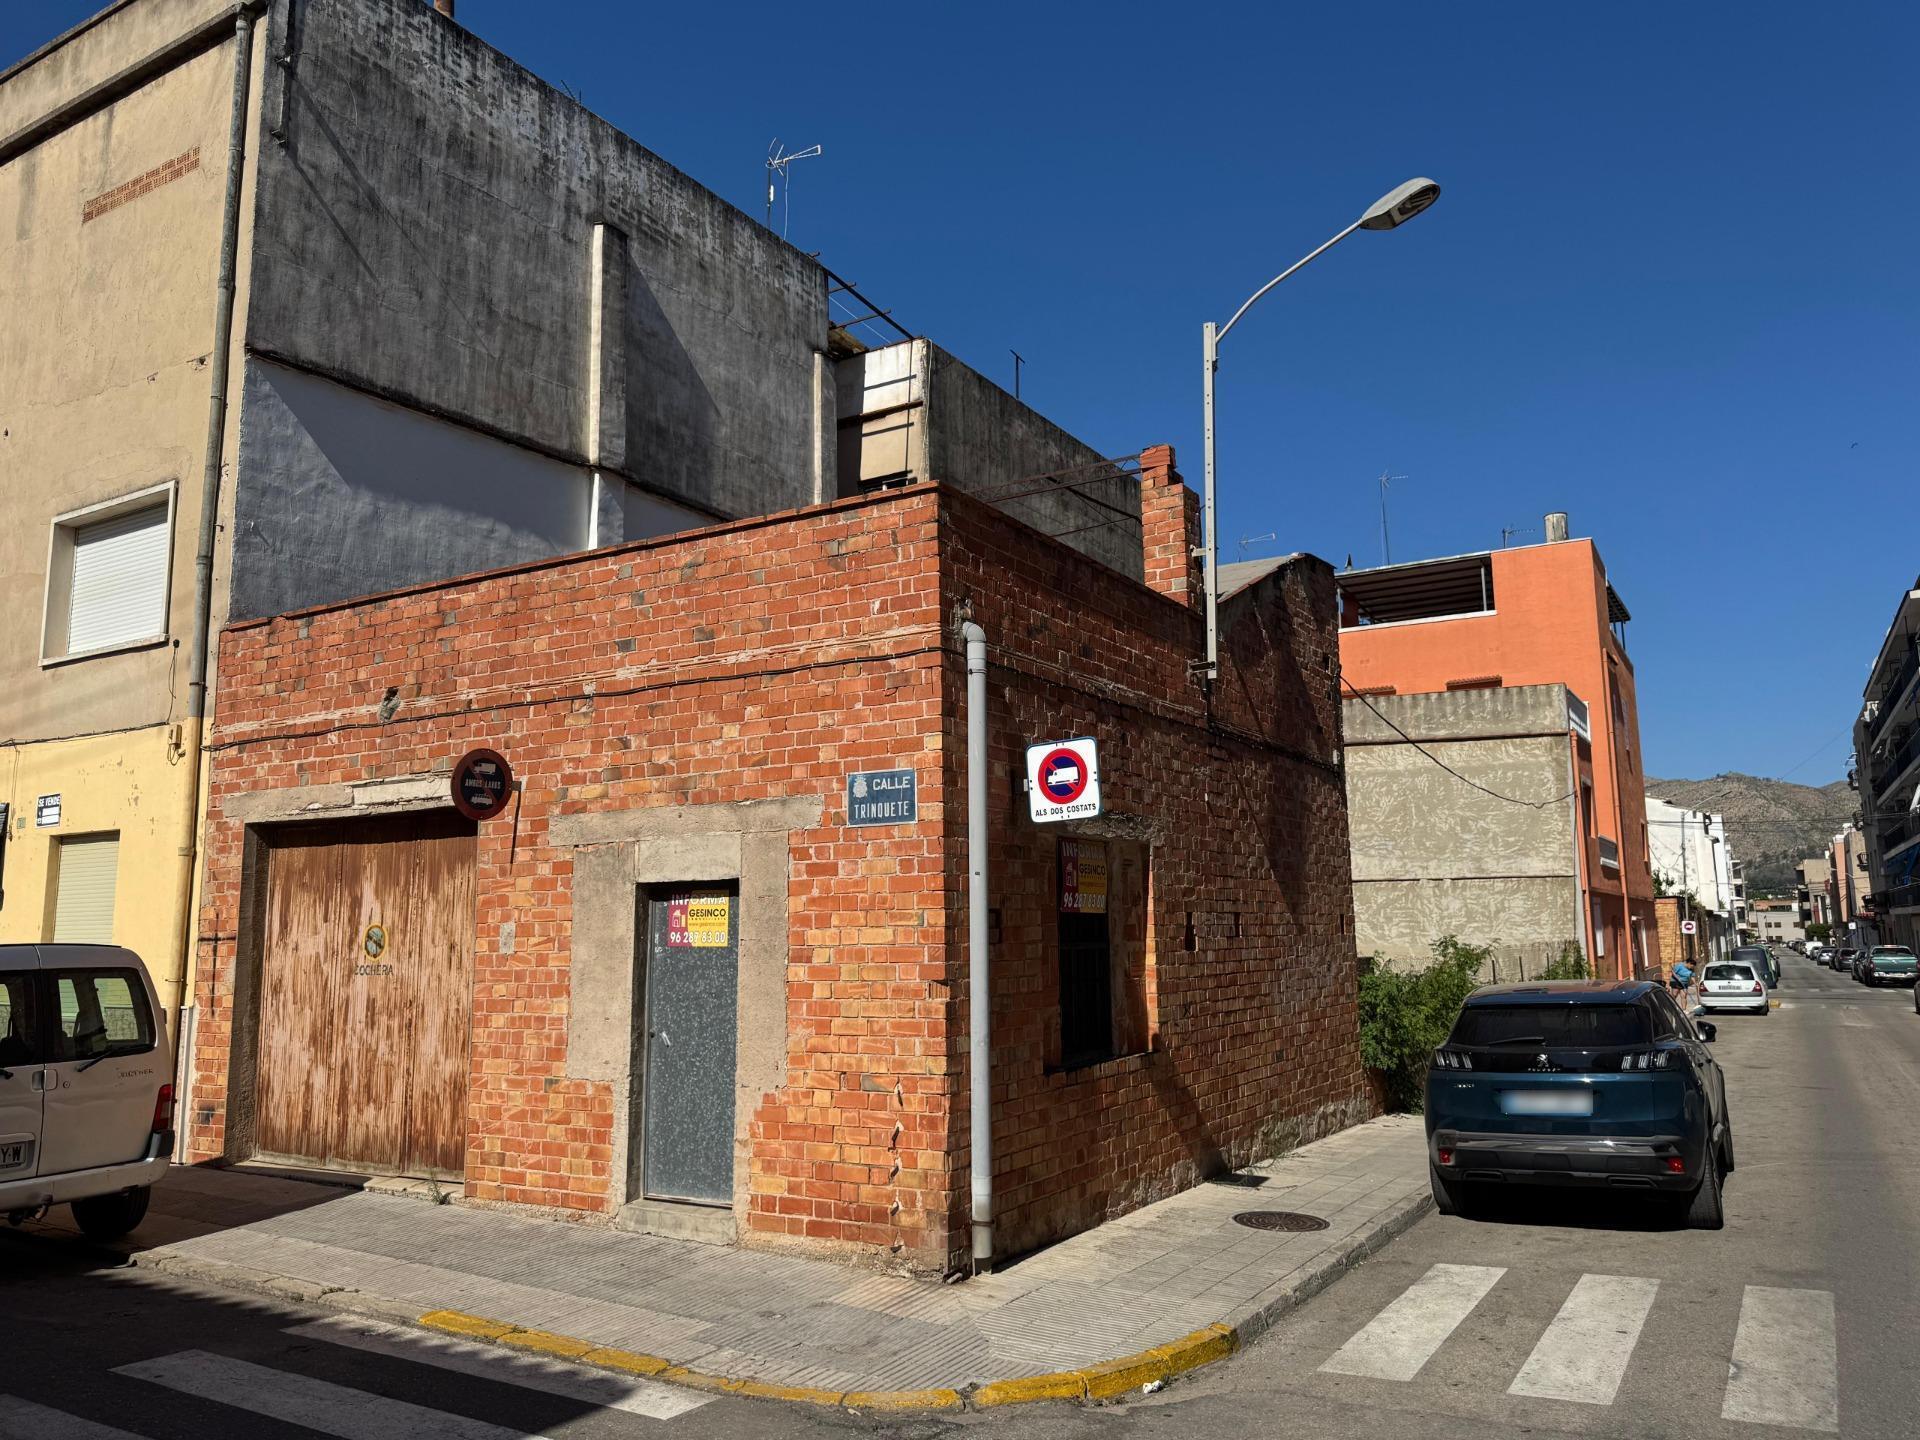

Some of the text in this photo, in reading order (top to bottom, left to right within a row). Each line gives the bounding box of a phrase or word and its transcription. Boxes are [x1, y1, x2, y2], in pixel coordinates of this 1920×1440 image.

[872, 776, 911, 791] CALLE
[38, 796, 61, 807] SE VENDE
[854, 800, 909, 819] TRINQUETE
[1035, 803, 1097, 817] ALS DOS COSTATS
[1061, 841, 1105, 859] INFORMA
[1078, 863, 1106, 876] GESINCO
[671, 894, 726, 906] INFORMA
[1063, 892, 1073, 907] 96
[689, 908, 727, 918] GESINCO
[670, 932, 681, 943] 96
[683, 932, 698, 943] 287
[701, 931, 713, 943] 83
[714, 931, 726, 943] 00
[354, 964, 394, 976] COCHERA
